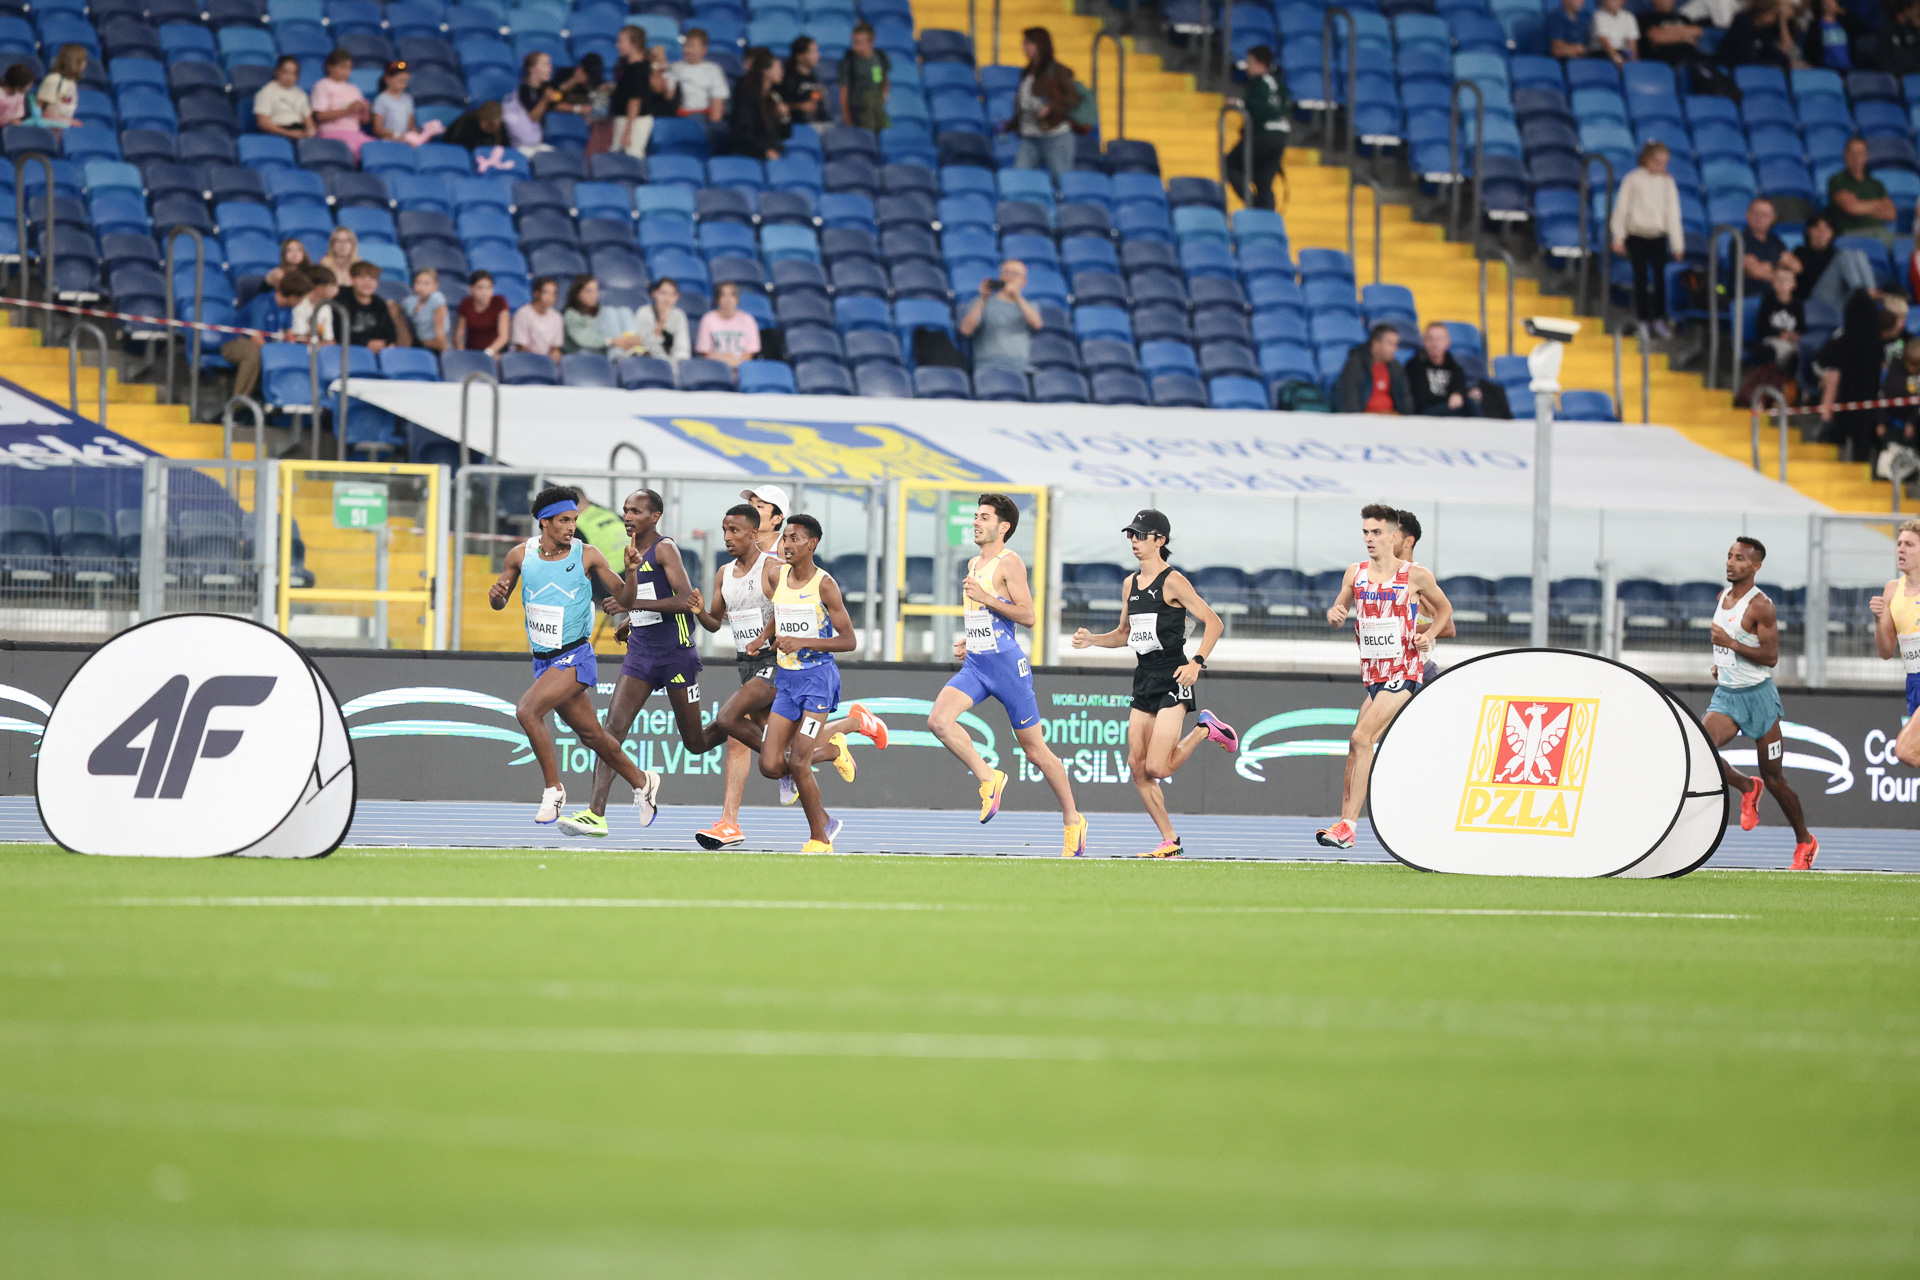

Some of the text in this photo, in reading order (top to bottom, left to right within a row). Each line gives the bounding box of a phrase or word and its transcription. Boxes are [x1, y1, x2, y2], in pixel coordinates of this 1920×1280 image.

[1359, 590, 1397, 601] CROATIA
[780, 621, 809, 633] ABDO
[1130, 631, 1154, 642] OBARA
[1363, 632, 1395, 646] BELCIĆ
[760, 667, 768, 676] 4
[1019, 660, 1028, 674] 10
[688, 686, 700, 700] 12
[1182, 684, 1190, 698] 8
[1052, 693, 1132, 707] WORLD ATHLETIC
[808, 720, 817, 735] 1
[1011, 709, 1131, 745] ontinen
[87, 674, 278, 799] 4F
[1770, 743, 1780, 757] 11
[1462, 788, 1569, 829] PZLA
